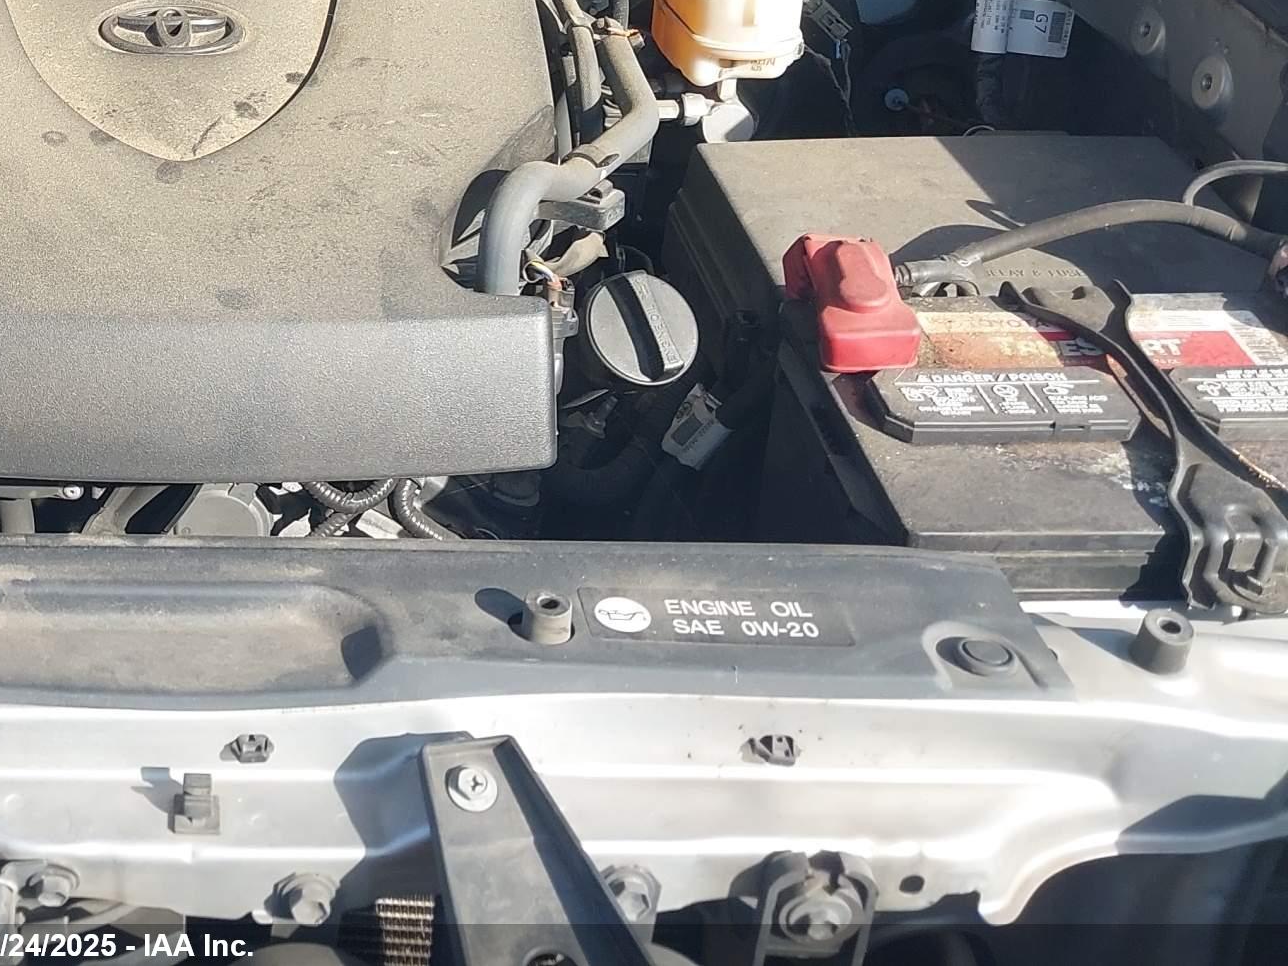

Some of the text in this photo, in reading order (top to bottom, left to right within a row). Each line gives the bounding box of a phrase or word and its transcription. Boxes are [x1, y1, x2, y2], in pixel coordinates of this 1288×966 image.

[1034, 13, 1049, 35] G7
[931, 373, 996, 383] DANGER
[1007, 372, 1068, 382] POISON
[664, 598, 813, 618] ENGINE OIL
[672, 619, 819, 638] SAE 0W-20
